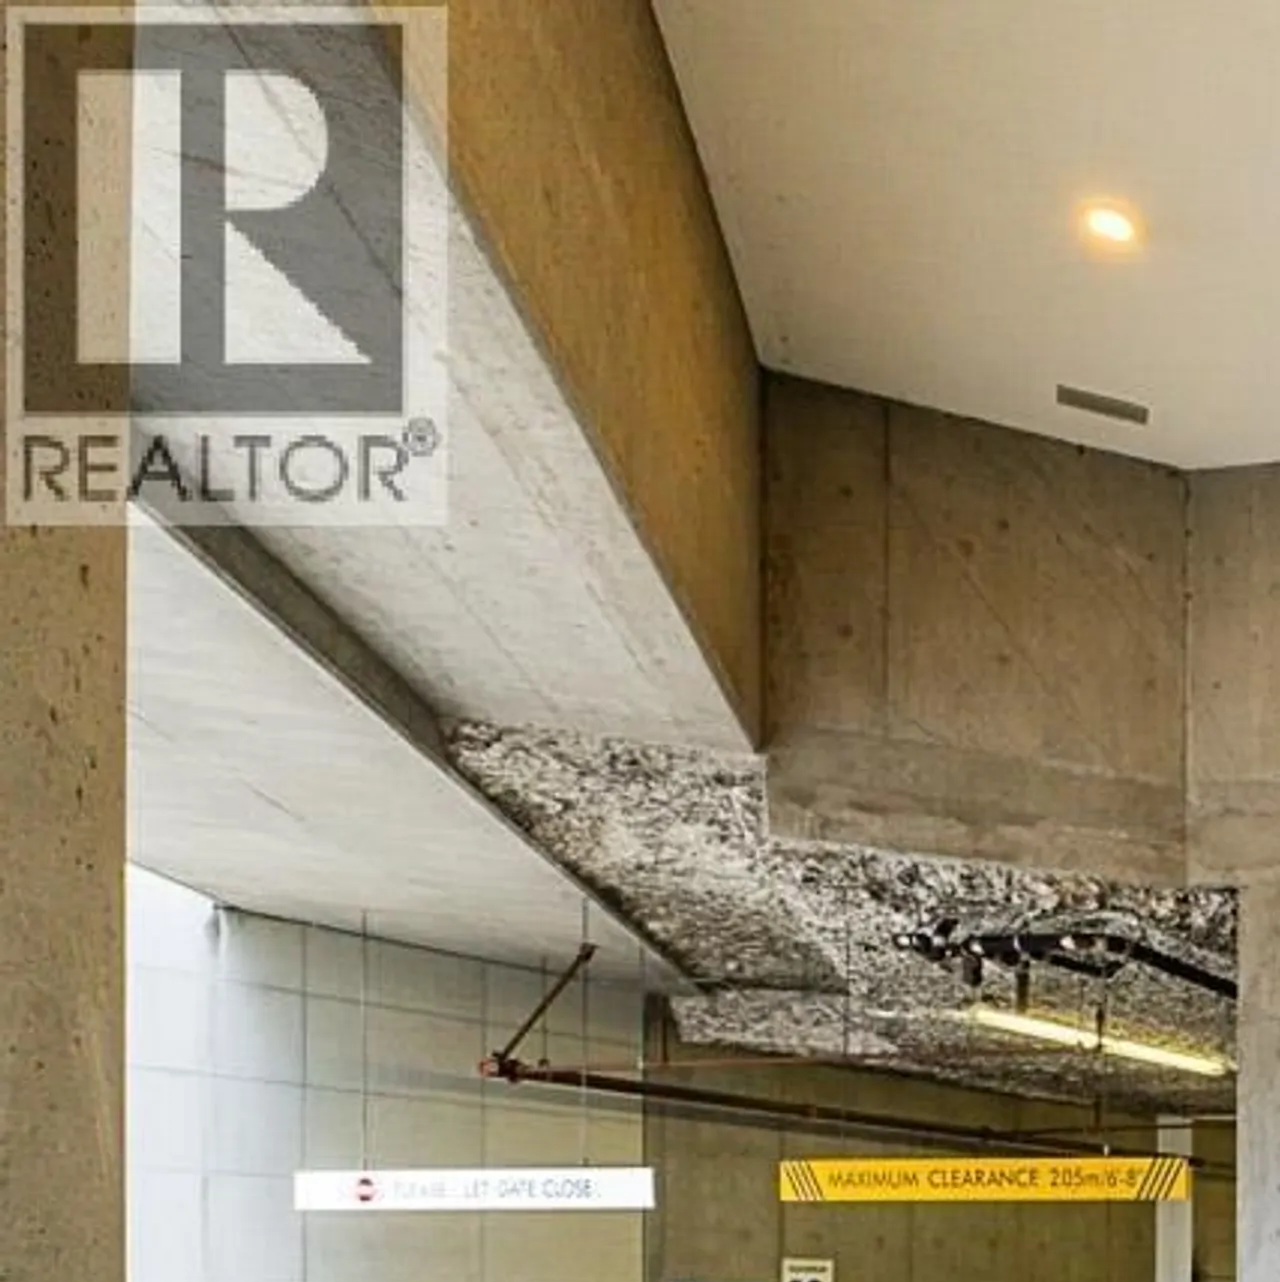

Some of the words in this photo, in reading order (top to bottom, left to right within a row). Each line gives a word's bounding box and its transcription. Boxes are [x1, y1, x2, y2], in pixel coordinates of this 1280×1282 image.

[463, 1178, 490, 1198] LET
[497, 1178, 536, 1198] GATE
[828, 1171, 920, 1189] MAXIMUM
[926, 1168, 1040, 1189] CLEARANCE
